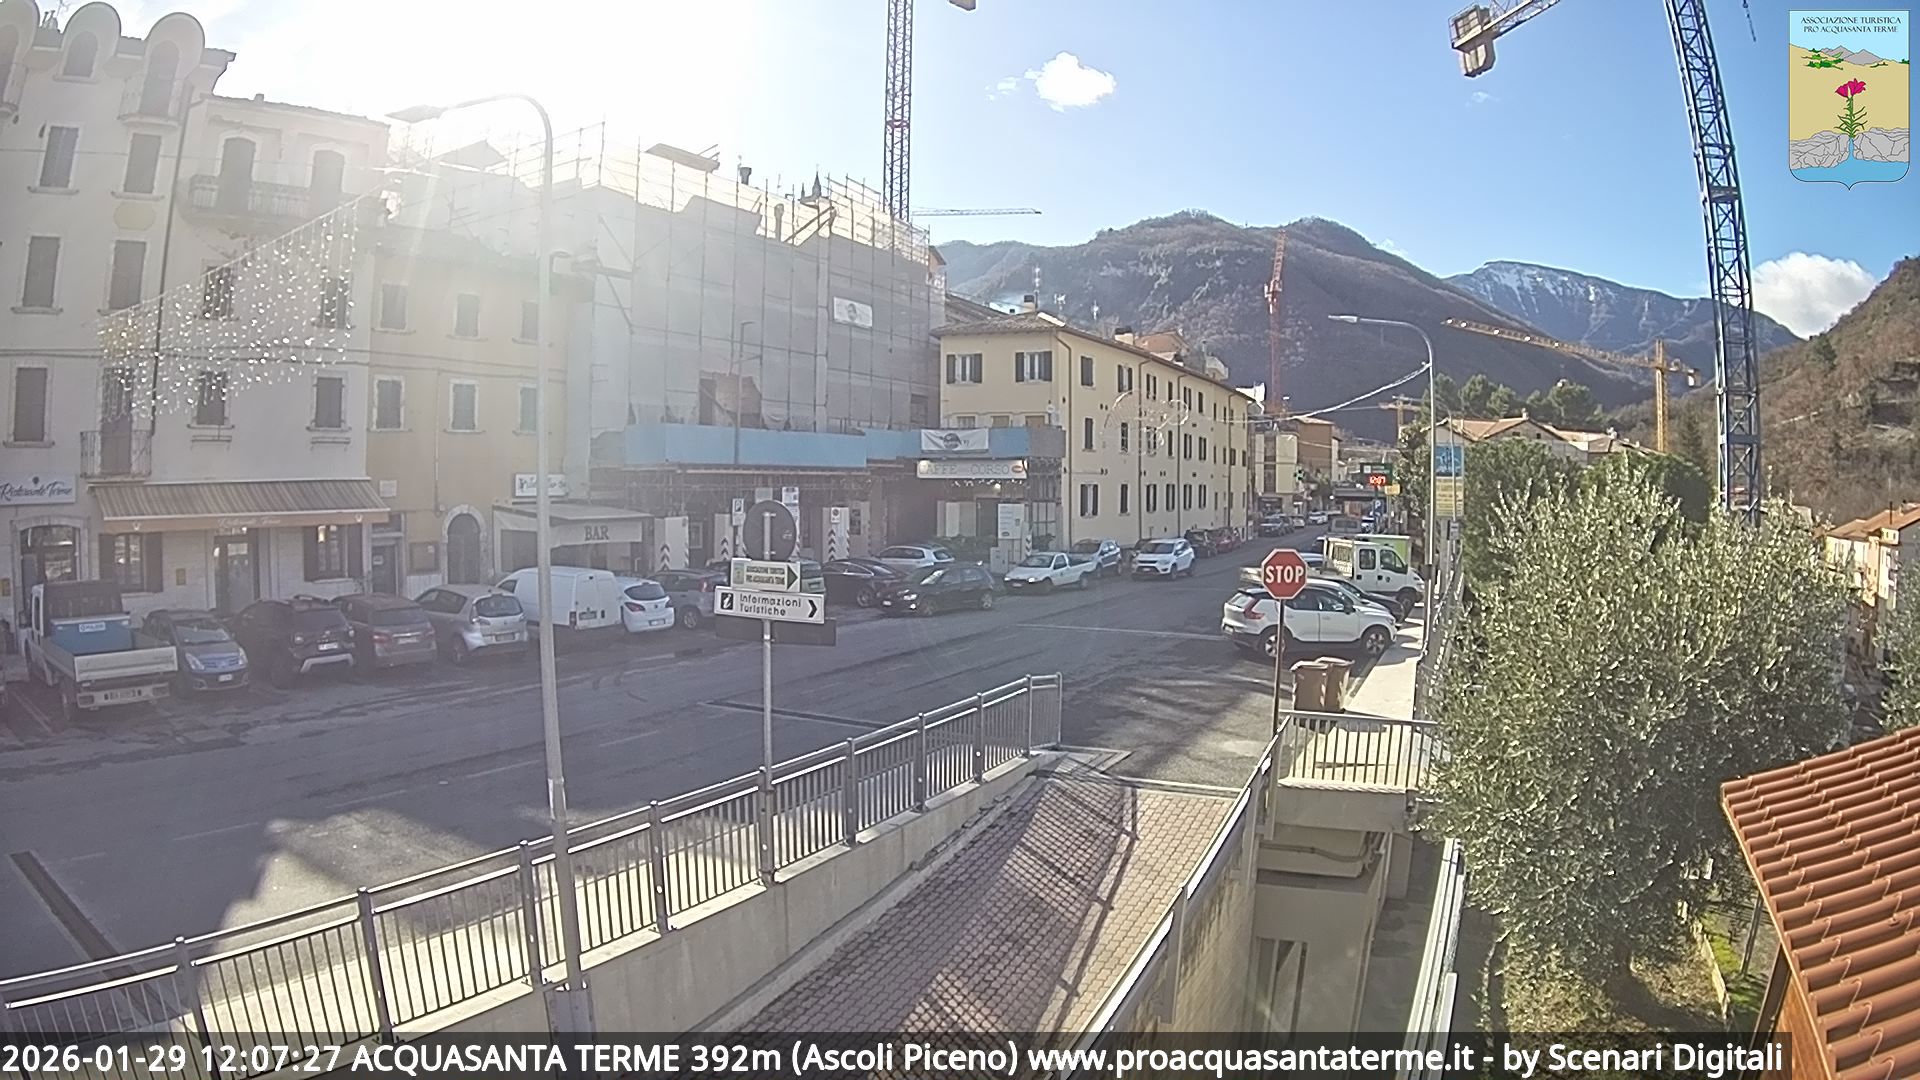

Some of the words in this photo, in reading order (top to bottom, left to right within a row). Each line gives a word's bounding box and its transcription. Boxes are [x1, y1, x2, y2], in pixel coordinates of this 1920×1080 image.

[584, 525, 609, 540] BAR
[1265, 565, 1305, 583] STOP
[740, 593, 802, 608] Informazioni
[740, 603, 786, 616] Turistiche
